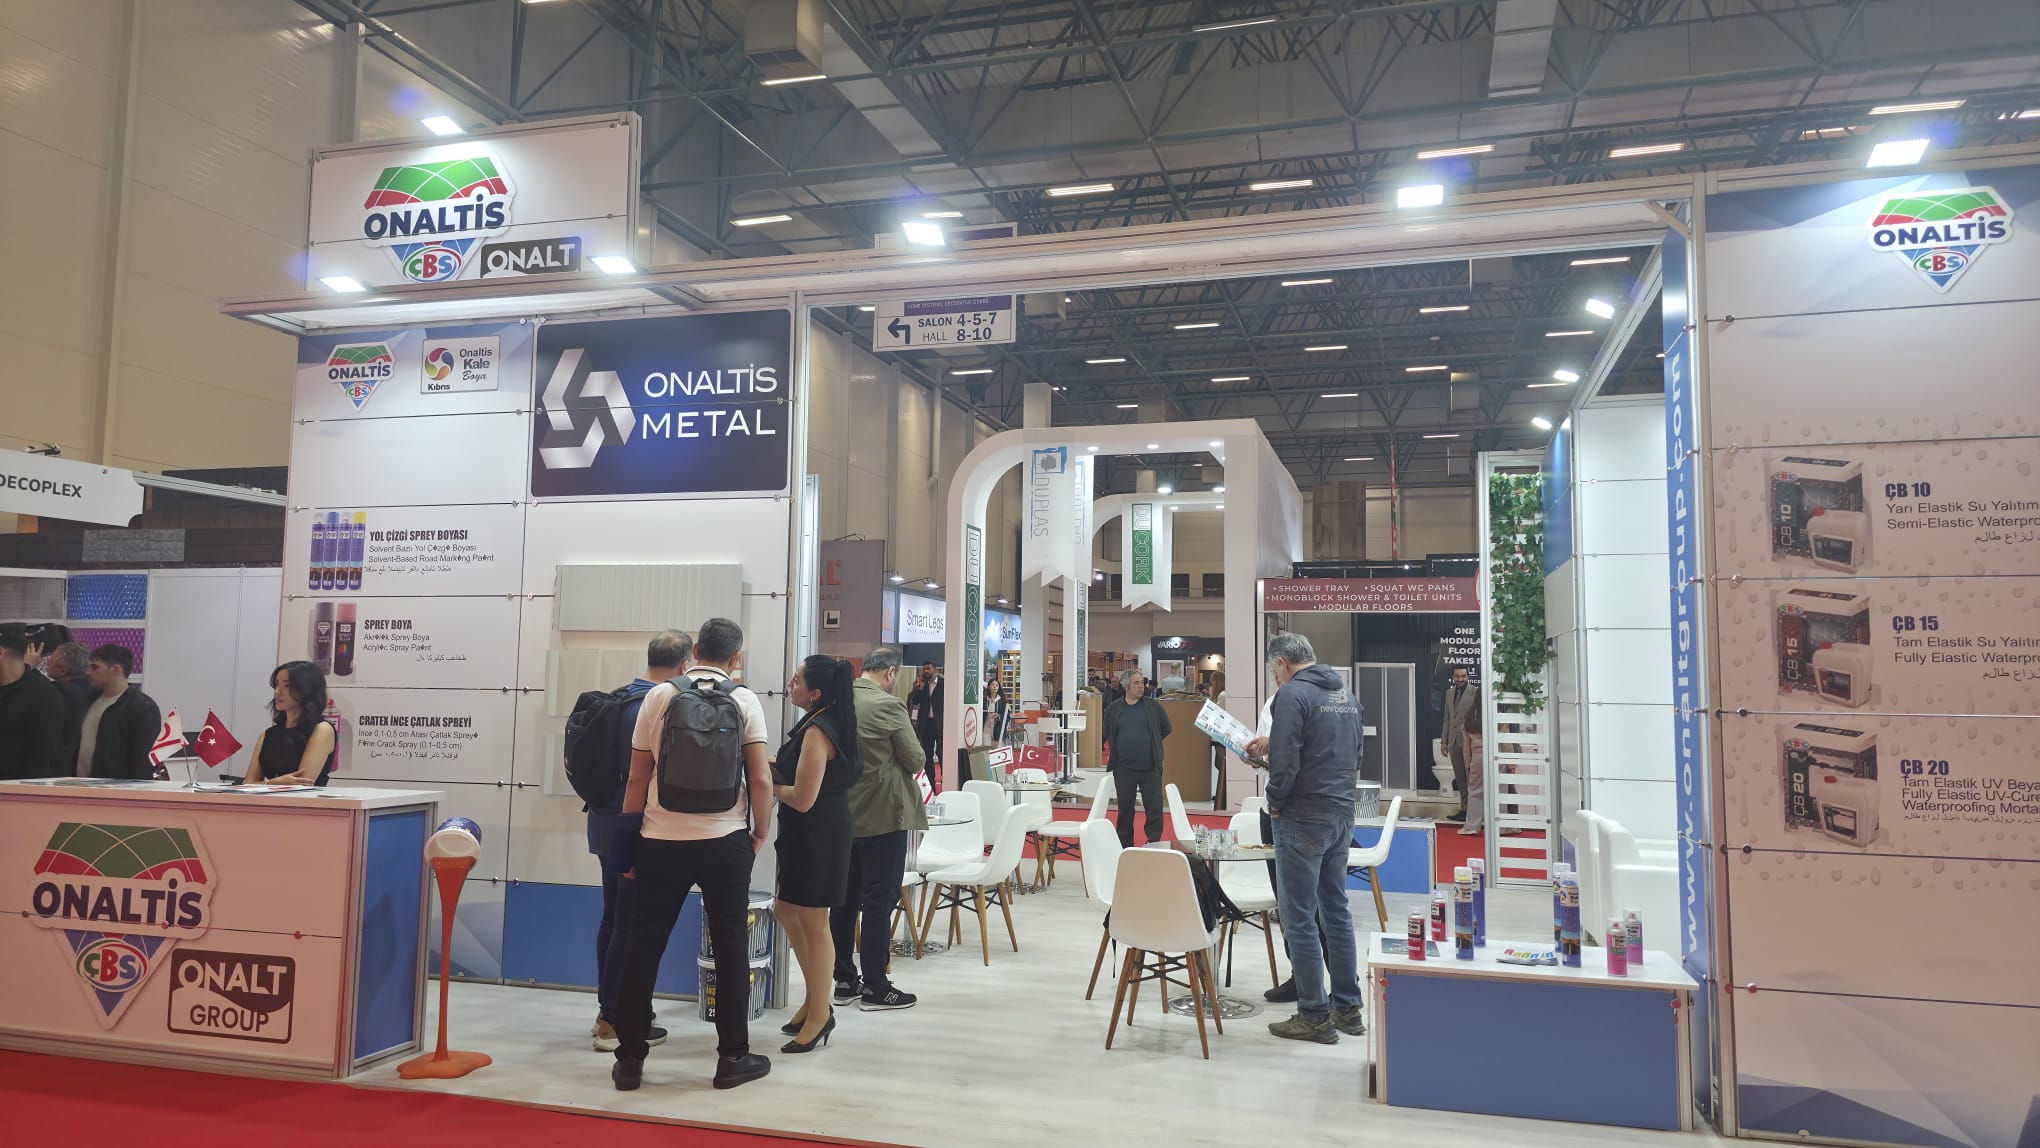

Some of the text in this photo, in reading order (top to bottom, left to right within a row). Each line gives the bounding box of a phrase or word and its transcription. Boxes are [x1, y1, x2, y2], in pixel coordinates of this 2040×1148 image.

[487, 243, 575, 271] ONALT
[918, 312, 997, 328] SALON 4-5-7
[923, 327, 992, 342] HALL 8-10
[459, 348, 492, 358] Onaltis
[464, 359, 490, 370] Kale
[462, 370, 487, 382] Boya
[642, 409, 776, 440] METAL
[1885, 481, 1931, 501] ÇB 10
[1918, 502, 1963, 513] Elastik
[1968, 501, 1987, 512] Su
[1887, 517, 1974, 529] Semi-Elastic
[369, 530, 384, 542] YOL
[386, 528, 408, 543] ÇİZGİ
[410, 530, 436, 541] SPREY
[437, 530, 468, 541] BOYASI
[369, 545, 394, 554] Solvent
[415, 544, 425, 552] Yol
[1134, 505, 1151, 583] DUCORK
[368, 555, 417, 564] Solvent-Based
[419, 555, 438, 563] Road
[1370, 584, 1455, 592] SQUAT WC PANS
[1432, 593, 1462, 601] UNITS
[1372, 603, 1413, 611] FLOORS
[364, 619, 412, 630] SPREY BOYA
[906, 609, 928, 628] Smart
[929, 613, 944, 633] Legs
[1892, 615, 1938, 634] ÇB 15
[1454, 627, 1475, 635] ONE
[391, 633, 410, 643] Sprey
[412, 633, 430, 643] Boya
[1893, 636, 1922, 647] Tam
[1927, 636, 1973, 647] Elastik
[1977, 636, 1996, 647] Su
[389, 644, 410, 653] Spray
[1670, 352, 1698, 955] www.onaltgroup.com
[1443, 656, 1475, 665] TAKES
[1894, 652, 1927, 665] Fully
[1931, 652, 1977, 662] Elastic
[359, 714, 471, 728] CRATEX İNCE ÇATLAK SPREYİ
[430, 731, 451, 741] Çatlak
[377, 740, 397, 749] Crack
[398, 741, 418, 751] Spray
[1900, 759, 1949, 778] ÇB 20
[1793, 773, 1804, 793] 20
[1901, 776, 1929, 787] Tam
[1934, 777, 1977, 789] Elastik
[1982, 778, 2003, 789] UV
[1902, 788, 1932, 801] Fully
[1937, 789, 1982, 801] Elastic
[1902, 800, 1995, 816] Waterproofing
[178, 959, 288, 996] ONALT
[189, 1004, 269, 1033] GROUP
